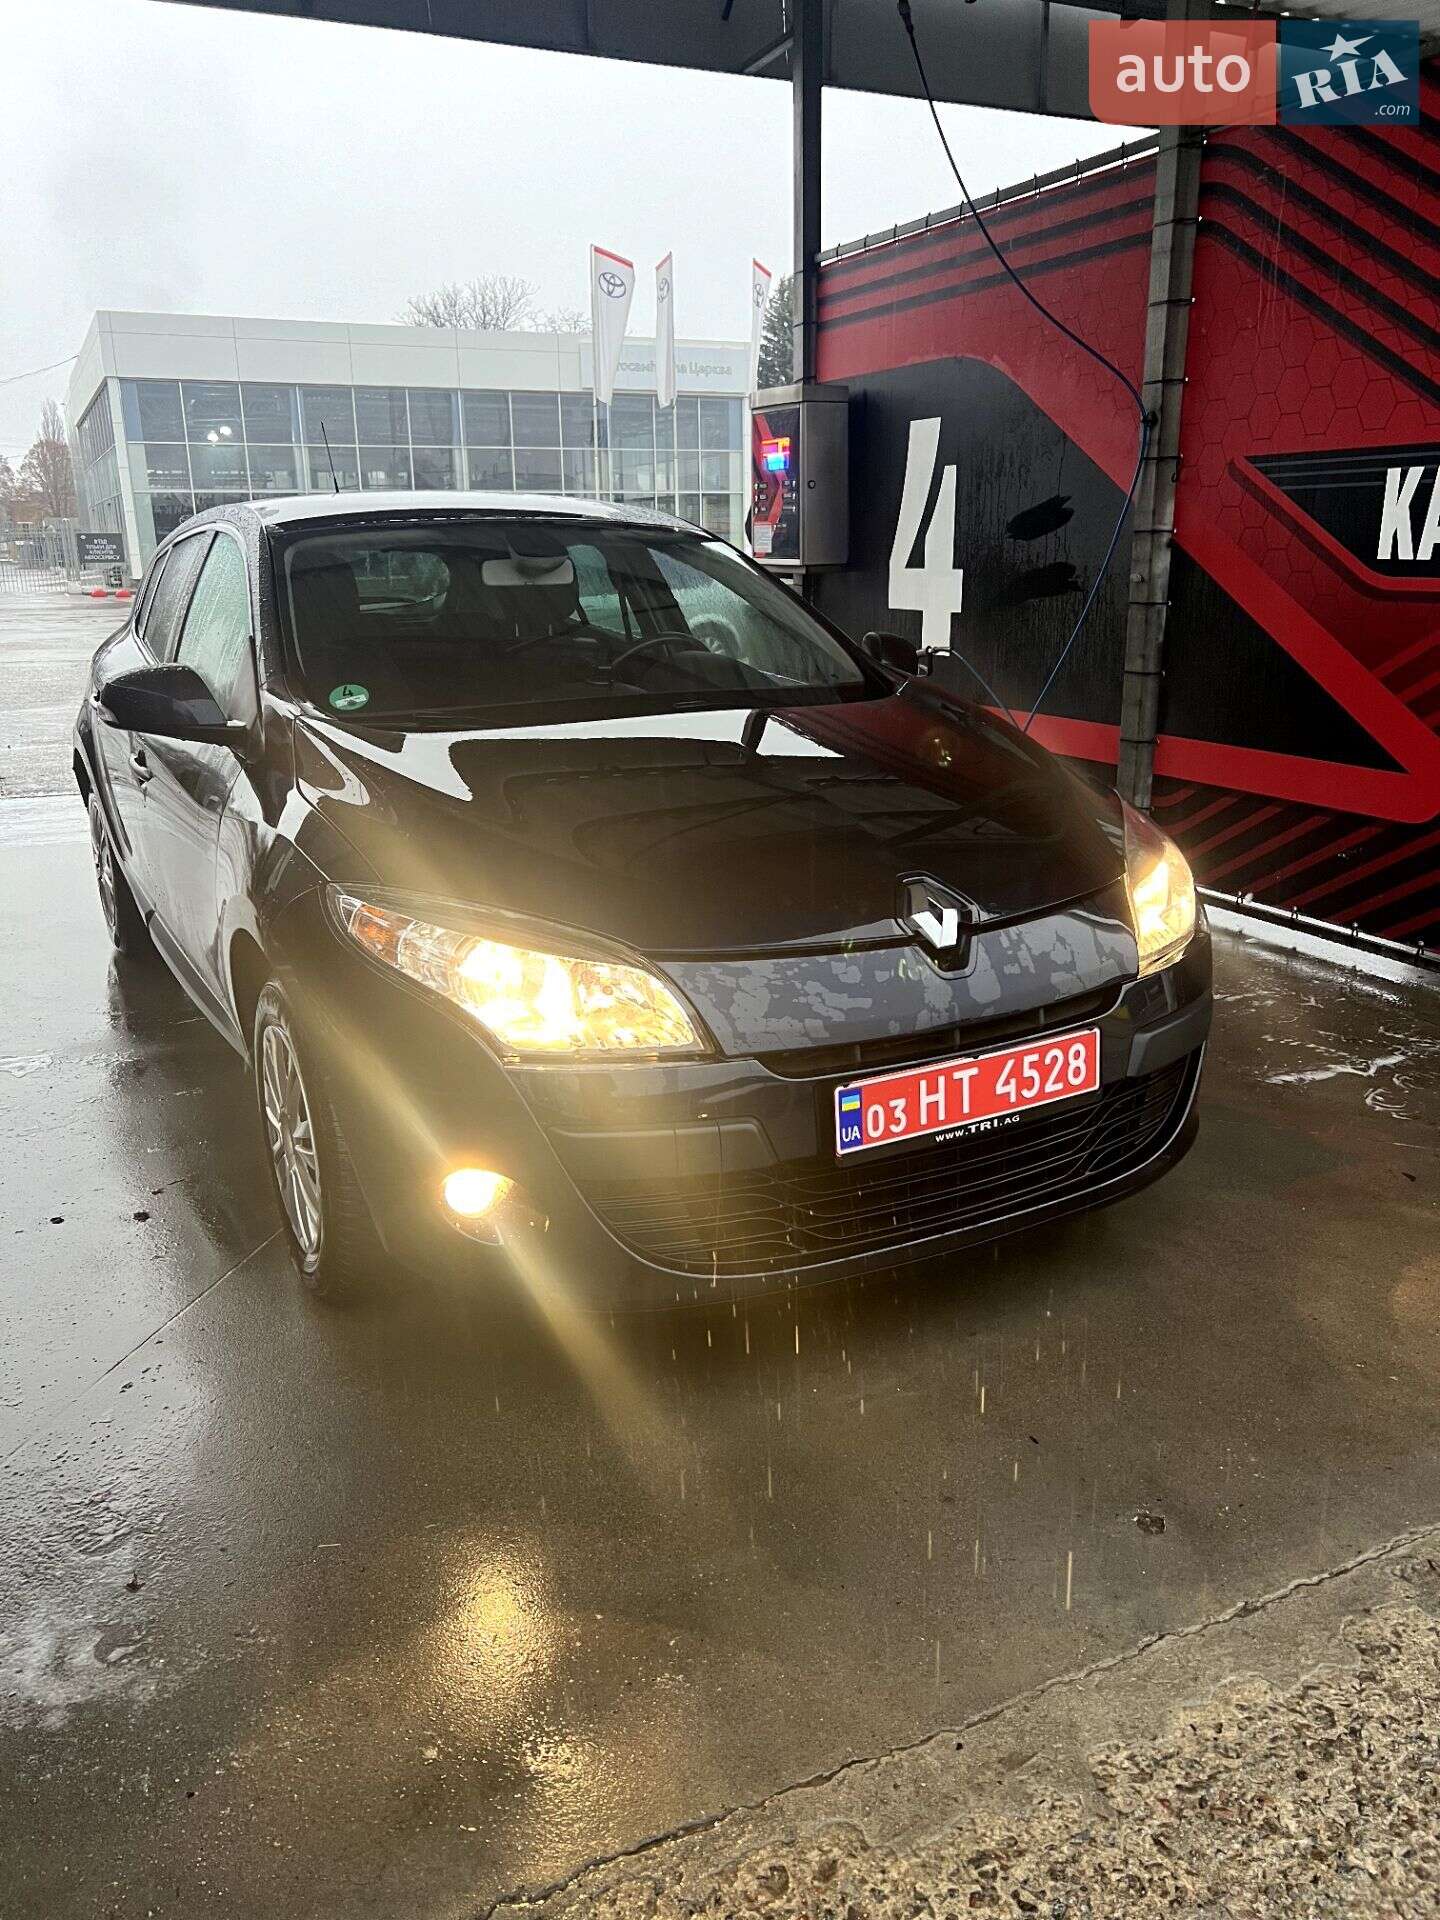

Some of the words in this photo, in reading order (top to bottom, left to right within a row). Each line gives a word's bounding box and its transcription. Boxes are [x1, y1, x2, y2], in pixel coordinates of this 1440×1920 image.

[888, 416, 964, 657] 4
[342, 686, 354, 697] 4
[866, 1097, 907, 1138] 03
[919, 1067, 980, 1126] HT
[995, 1042, 1087, 1104] 4528
[842, 1126, 861, 1143] UA
